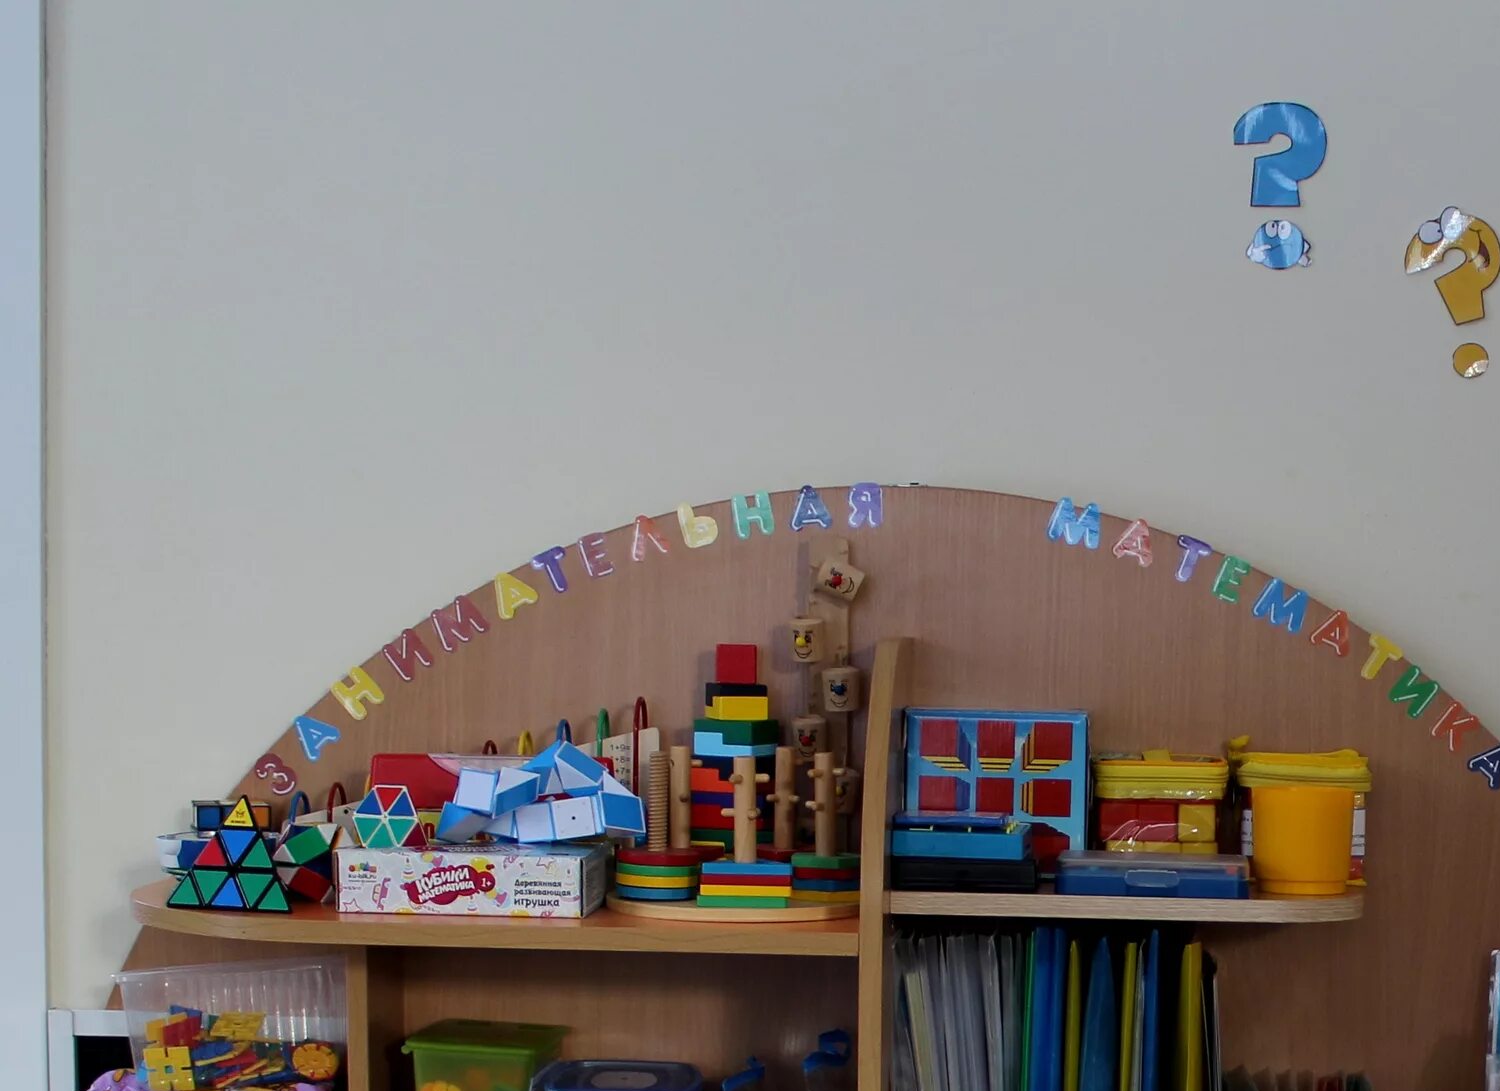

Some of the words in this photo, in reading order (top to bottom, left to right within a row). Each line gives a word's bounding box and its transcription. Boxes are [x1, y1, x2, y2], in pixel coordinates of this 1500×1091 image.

[255, 482, 884, 795] ЗАНИМАТЕЛЬНАЯ
[415, 868, 470, 893] КУБИКИ
[480, 877, 492, 888] 1+
[514, 879, 562, 888] Деревянная
[418, 881, 475, 902] МАТЕМАТИКА
[514, 888, 571, 897] развивающая
[514, 898, 560, 907] игрушка
